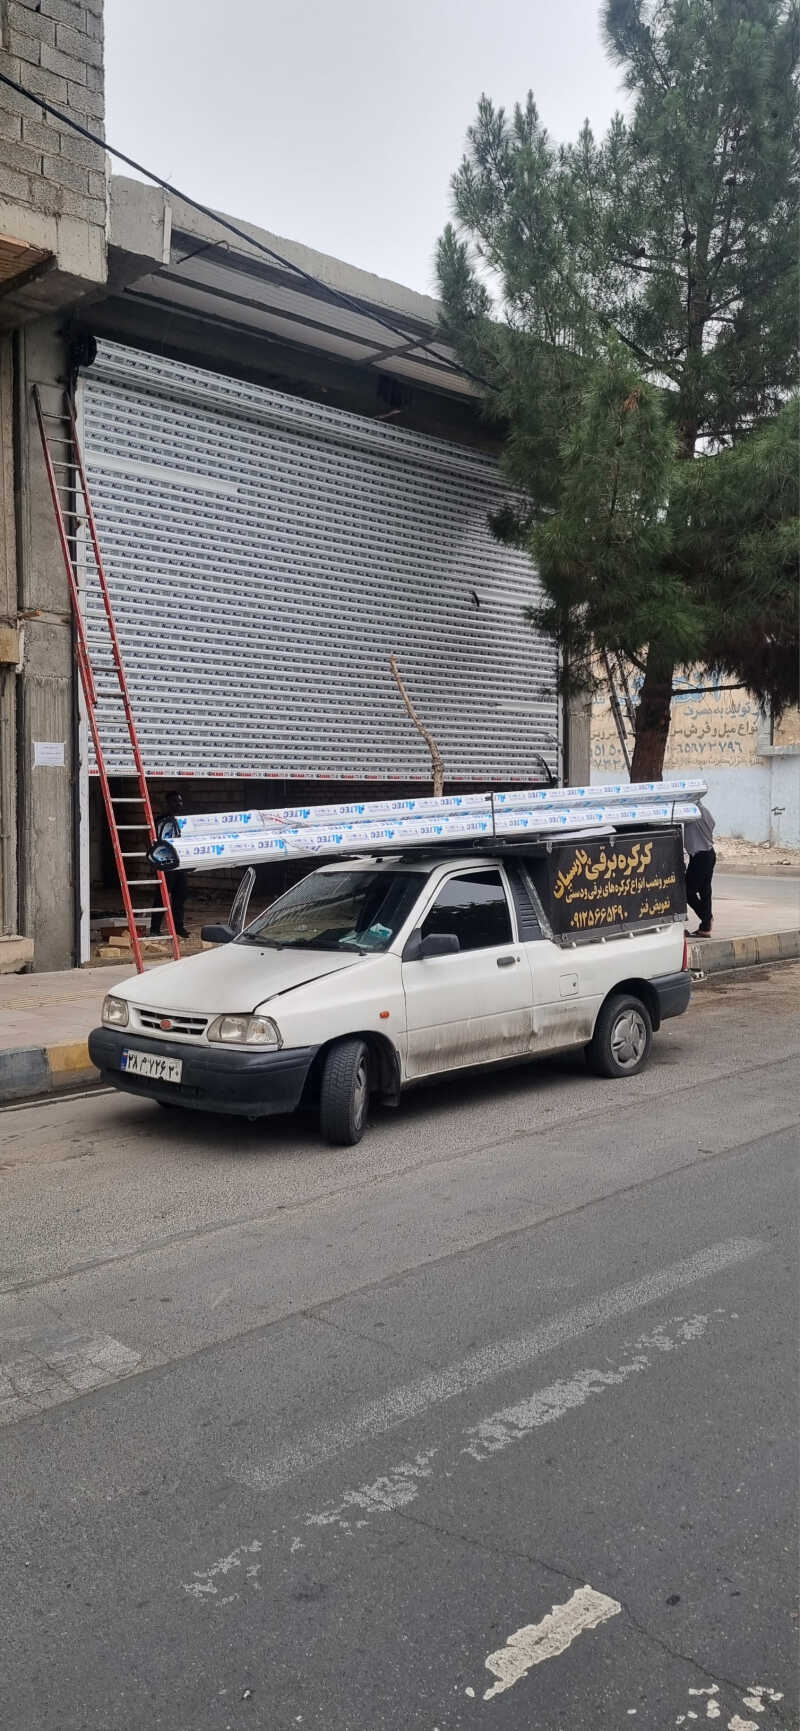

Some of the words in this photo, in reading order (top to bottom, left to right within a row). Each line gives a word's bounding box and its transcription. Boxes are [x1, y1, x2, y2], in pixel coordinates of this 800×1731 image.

[737, 721, 758, 737] نواع
[221, 813, 252, 824] ALTEC
[193, 844, 225, 856] ALTEC
[585, 845, 617, 880] برقی
[617, 841, 653, 875] کرکره
[553, 849, 592, 899] پارسیان
